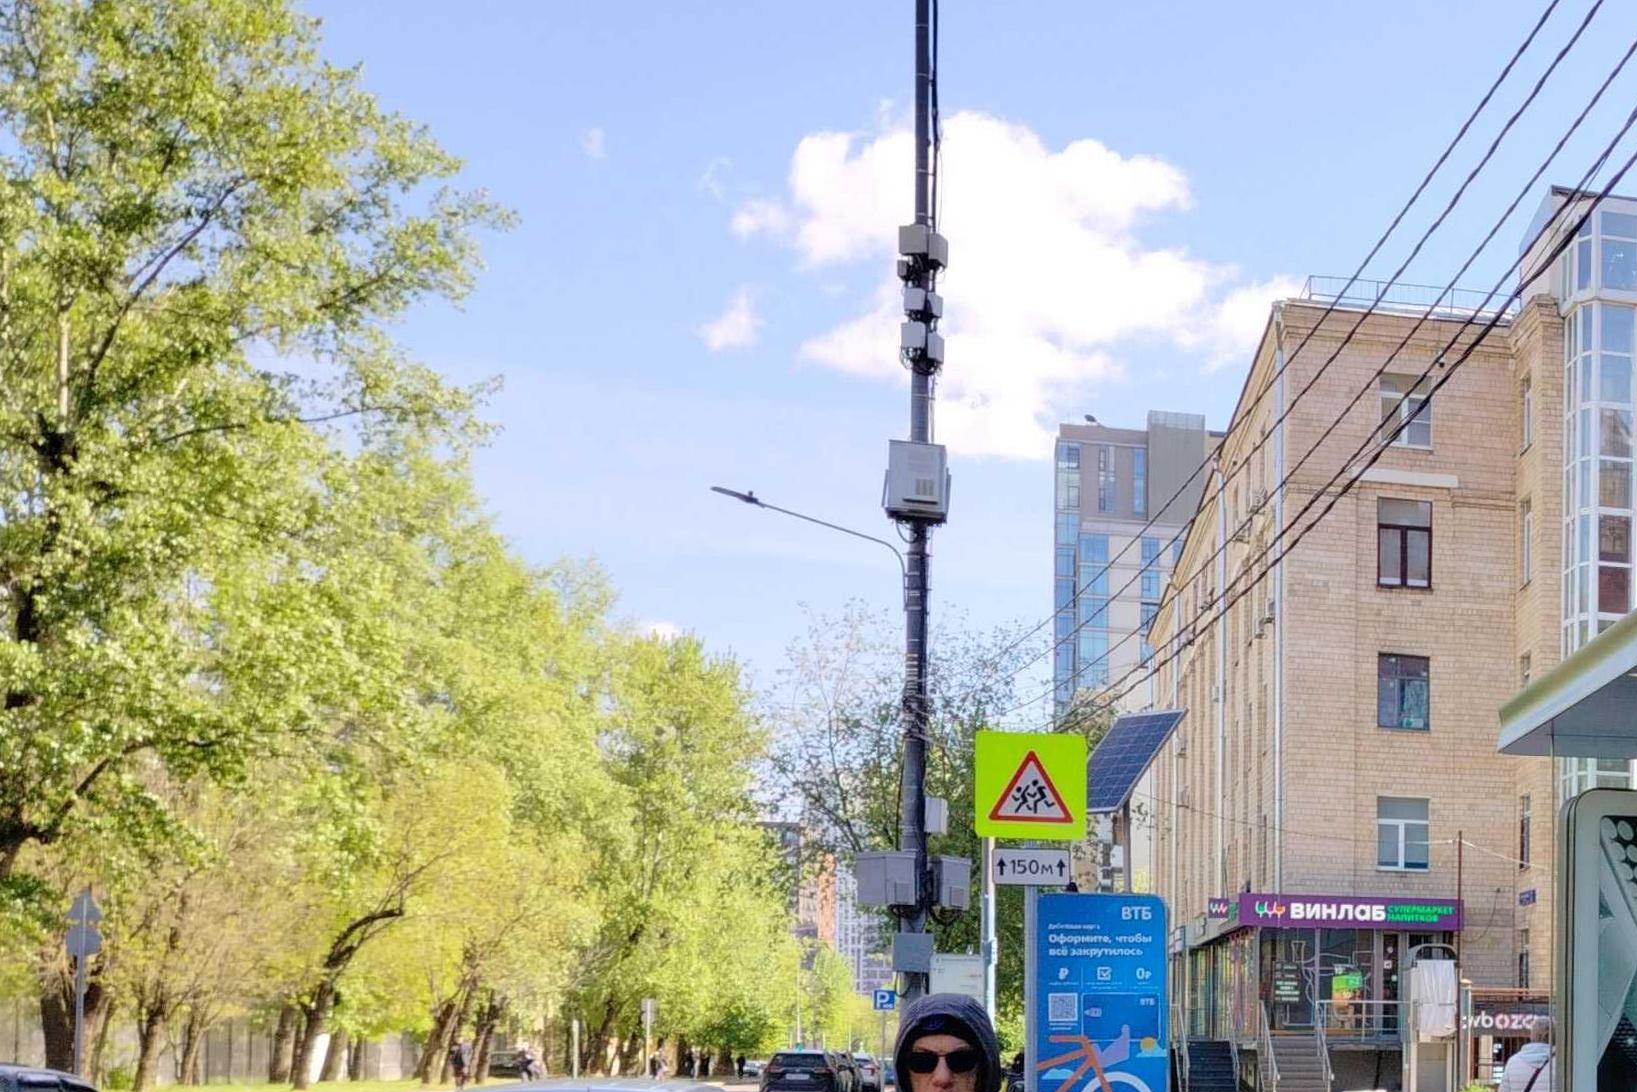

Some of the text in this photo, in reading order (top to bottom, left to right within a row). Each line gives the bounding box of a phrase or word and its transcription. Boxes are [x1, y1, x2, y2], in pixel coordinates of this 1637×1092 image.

[1121, 906, 1152, 920] ВТБ
[1388, 904, 1455, 915] СУПЕРМАРКЕТ
[1388, 914, 1439, 923] НАПИТКОВ
[1048, 933, 1152, 945] Оформите, чтобы
[1048, 945, 1144, 958] всё закрутилось
